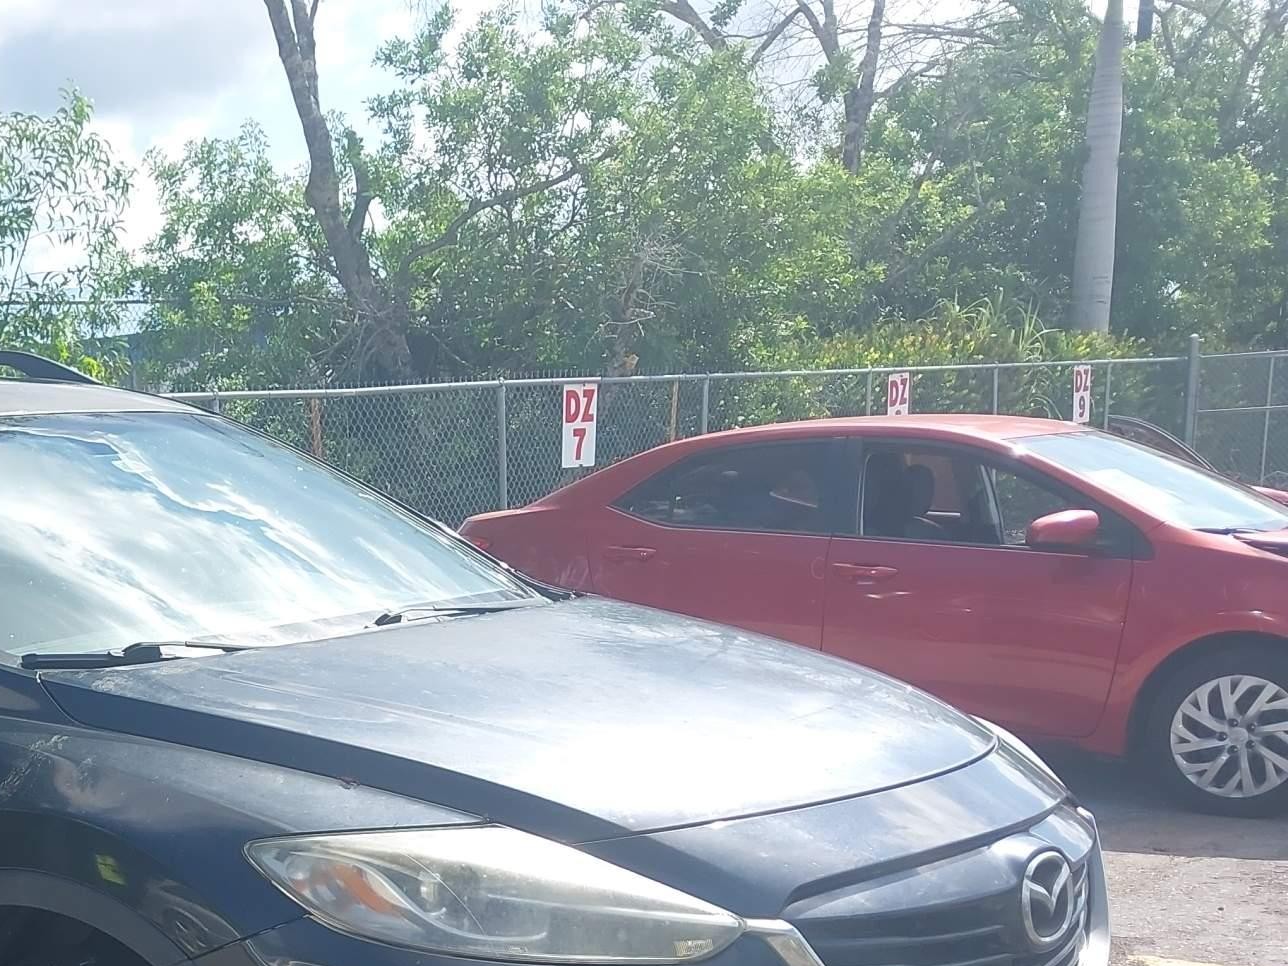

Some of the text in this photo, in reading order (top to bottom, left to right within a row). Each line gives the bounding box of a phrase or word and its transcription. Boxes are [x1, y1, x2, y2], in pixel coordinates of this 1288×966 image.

[889, 377, 908, 407] DZ
[1075, 368, 1089, 393] DZ
[565, 388, 595, 423] DZ
[1078, 395, 1086, 418] 9
[573, 428, 587, 460] 7
